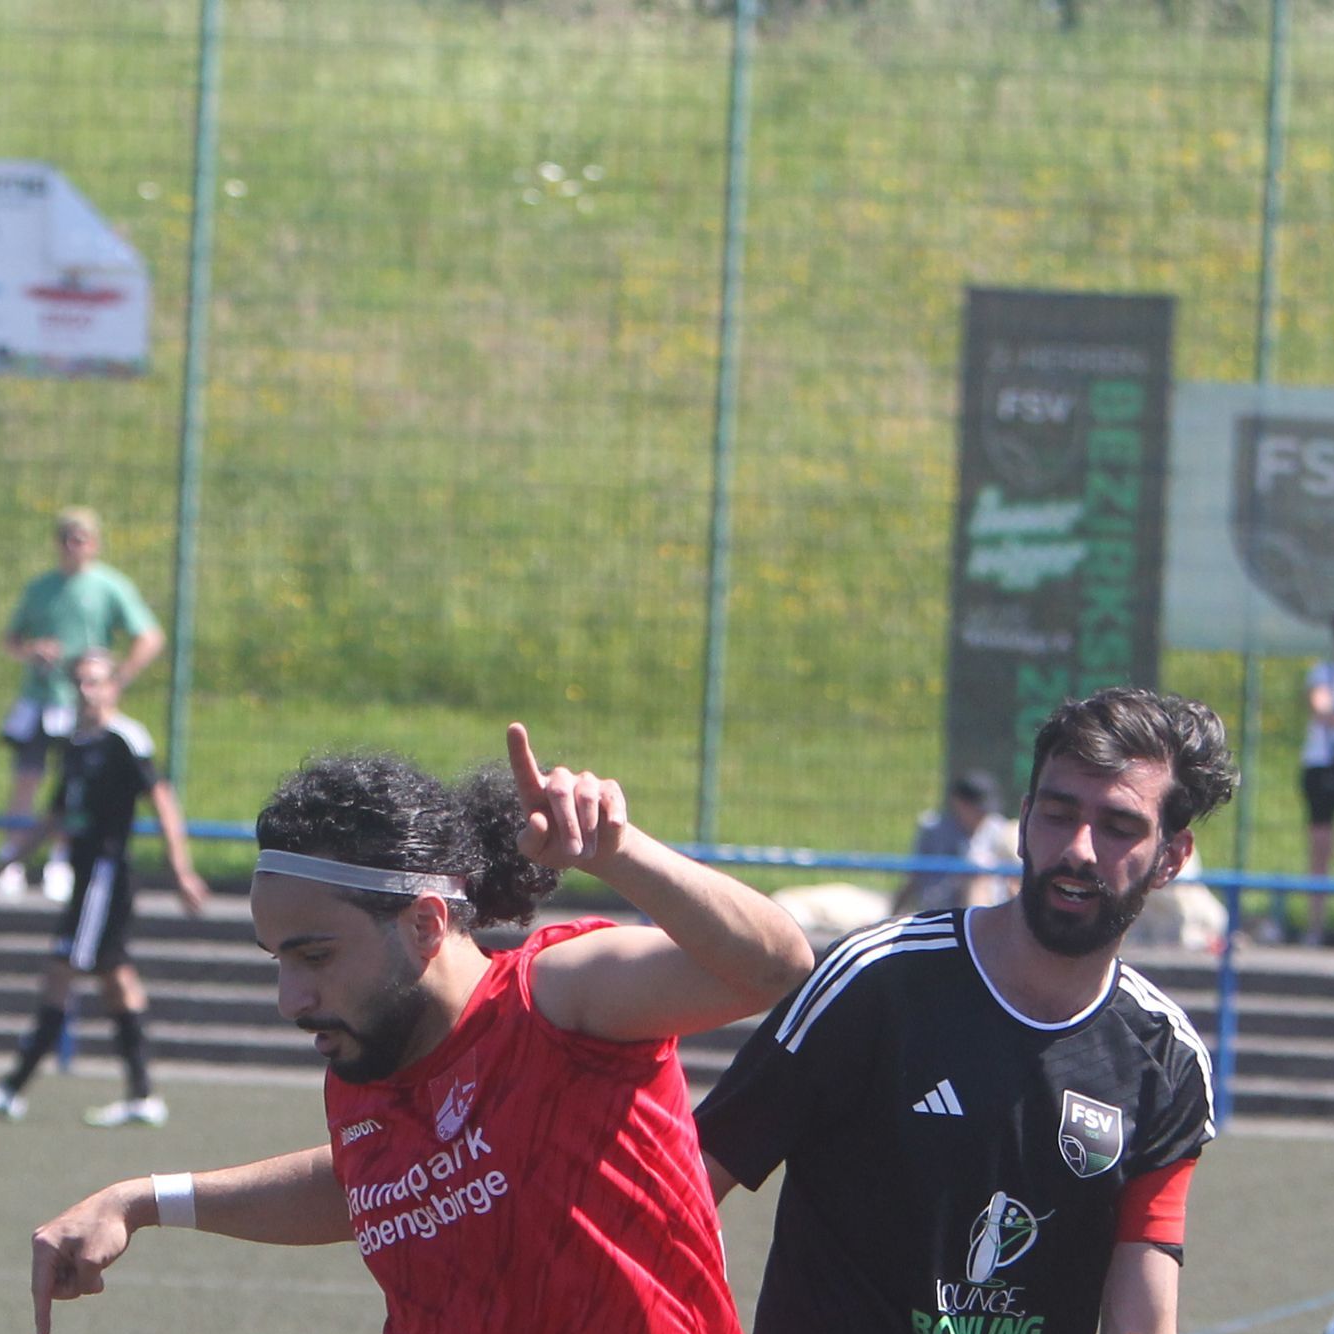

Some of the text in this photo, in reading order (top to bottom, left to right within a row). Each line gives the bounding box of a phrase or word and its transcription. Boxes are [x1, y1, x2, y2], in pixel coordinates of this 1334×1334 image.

[1070, 1101, 1114, 1134] FSV
[346, 1125, 492, 1222] aunapark
[935, 1278, 1026, 1318] LOUNGE
